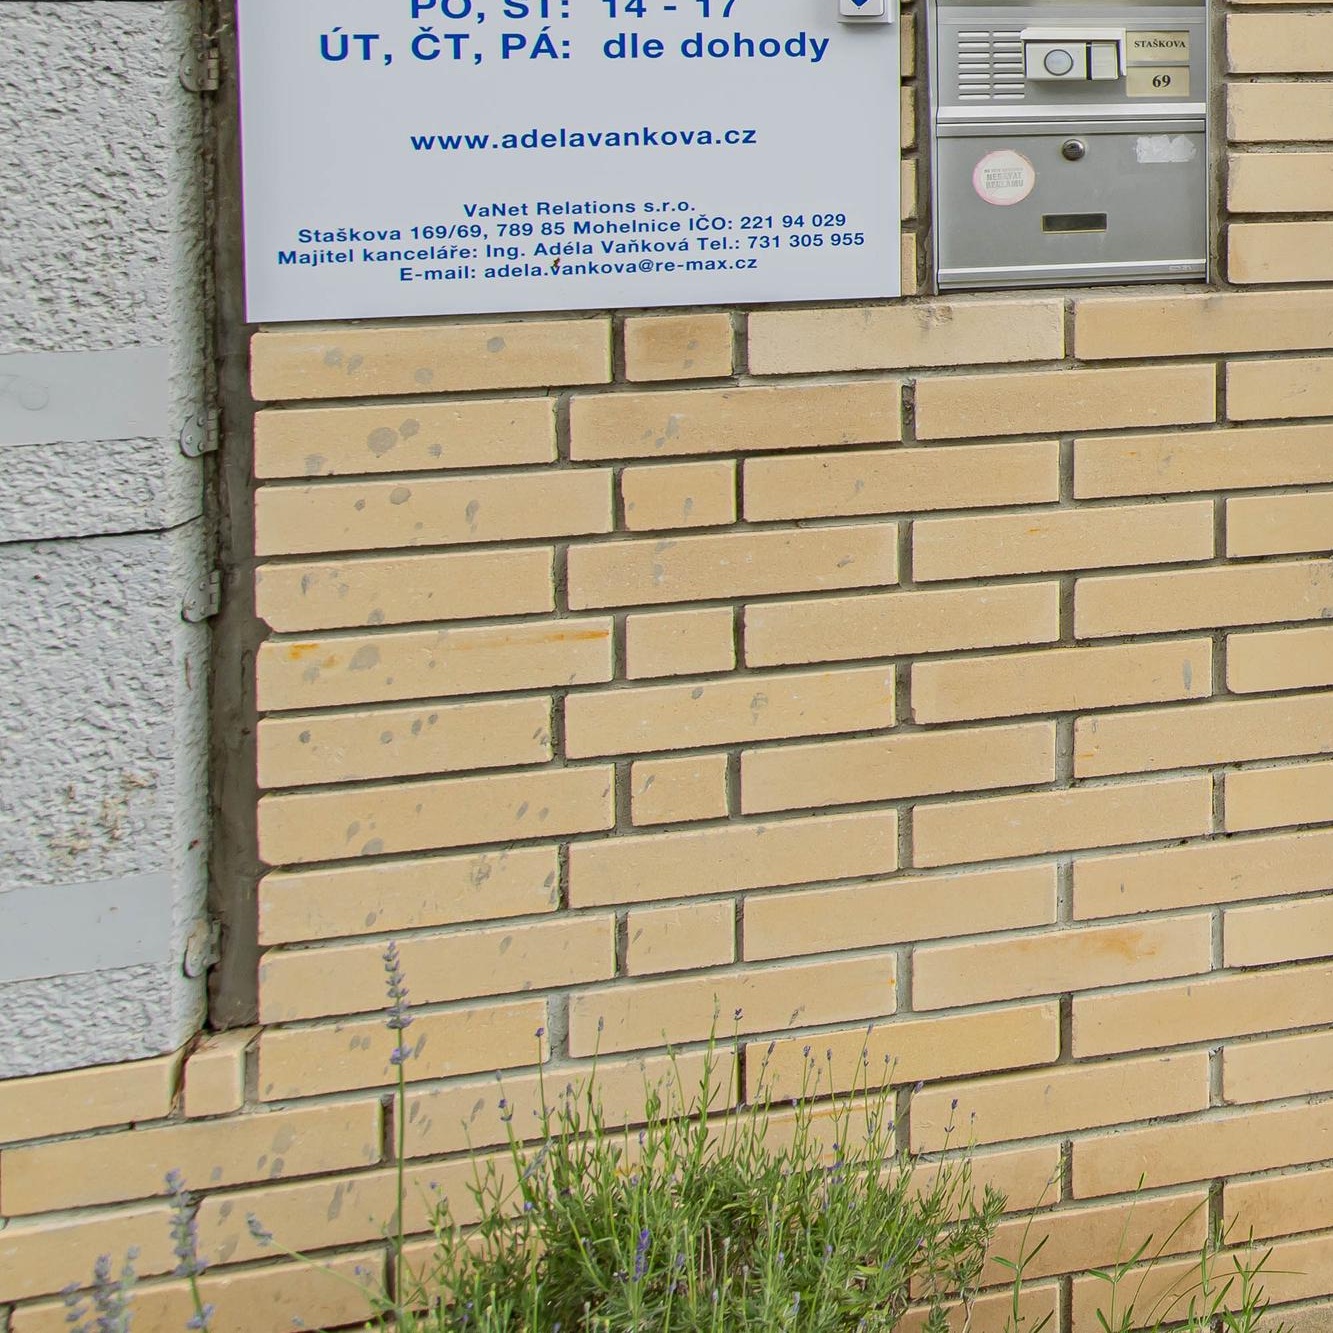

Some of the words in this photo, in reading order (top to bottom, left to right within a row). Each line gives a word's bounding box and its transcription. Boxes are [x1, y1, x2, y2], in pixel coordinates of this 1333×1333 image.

[319, 25, 393, 66] ÚT,
[410, 25, 483, 65] ČT,
[500, 24, 572, 60] PÁ:
[602, 32, 665, 60] dle
[679, 30, 831, 64] dohody
[1133, 38, 1187, 49] STAŠKOVA
[1151, 74, 1172, 88] 69
[410, 126, 757, 152] www.adelavankova.cz
[463, 201, 528, 219] VaNet
[536, 200, 636, 217] Relations
[644, 201, 696, 213] s.r.o.
[298, 226, 401, 244] Staškova
[411, 224, 489, 242] 169/69,
[498, 222, 533, 237] 789
[540, 221, 566, 236] 85
[572, 218, 680, 235] Mohelnice
[689, 213, 733, 231] IČO:
[740, 215, 773, 230] 221
[781, 214, 805, 229] 94
[812, 213, 847, 228] 029
[276, 249, 354, 267] Majitel
[361, 244, 478, 263] kanceláře:
[485, 242, 526, 260] Ing.
[532, 239, 594, 257] Adéla
[600, 236, 690, 254] Vaňková
[698, 235, 740, 251] Tel.:
[747, 234, 780, 250] 731
[790, 233, 824, 248] 305
[830, 231, 865, 247] 955
[399, 264, 477, 282] E-mail:
[483, 257, 758, 280] adela.vankova@re-max.cz
